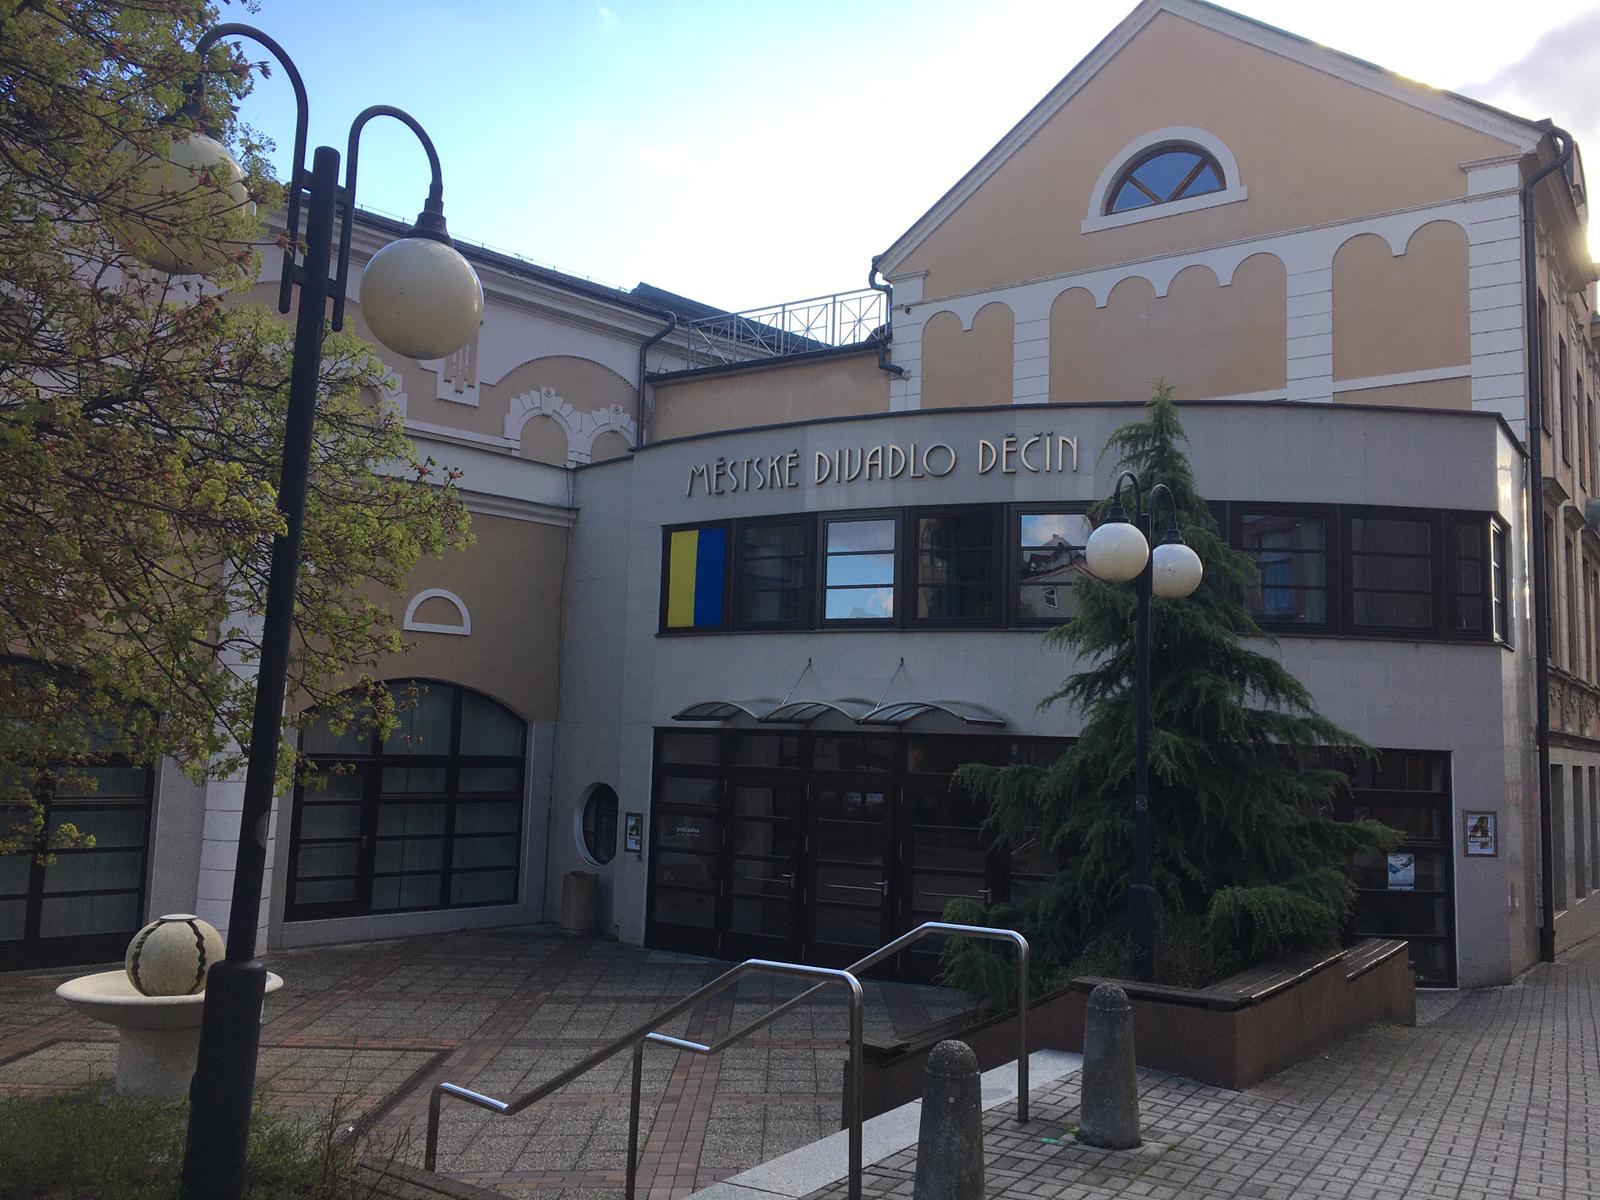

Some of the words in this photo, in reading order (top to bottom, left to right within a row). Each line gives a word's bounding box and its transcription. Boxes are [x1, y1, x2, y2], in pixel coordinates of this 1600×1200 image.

[686, 448, 800, 498] MĚSTSKÉ
[814, 443, 956, 485] DIVADLO
[978, 431, 1078, 475] DĚČÍN
